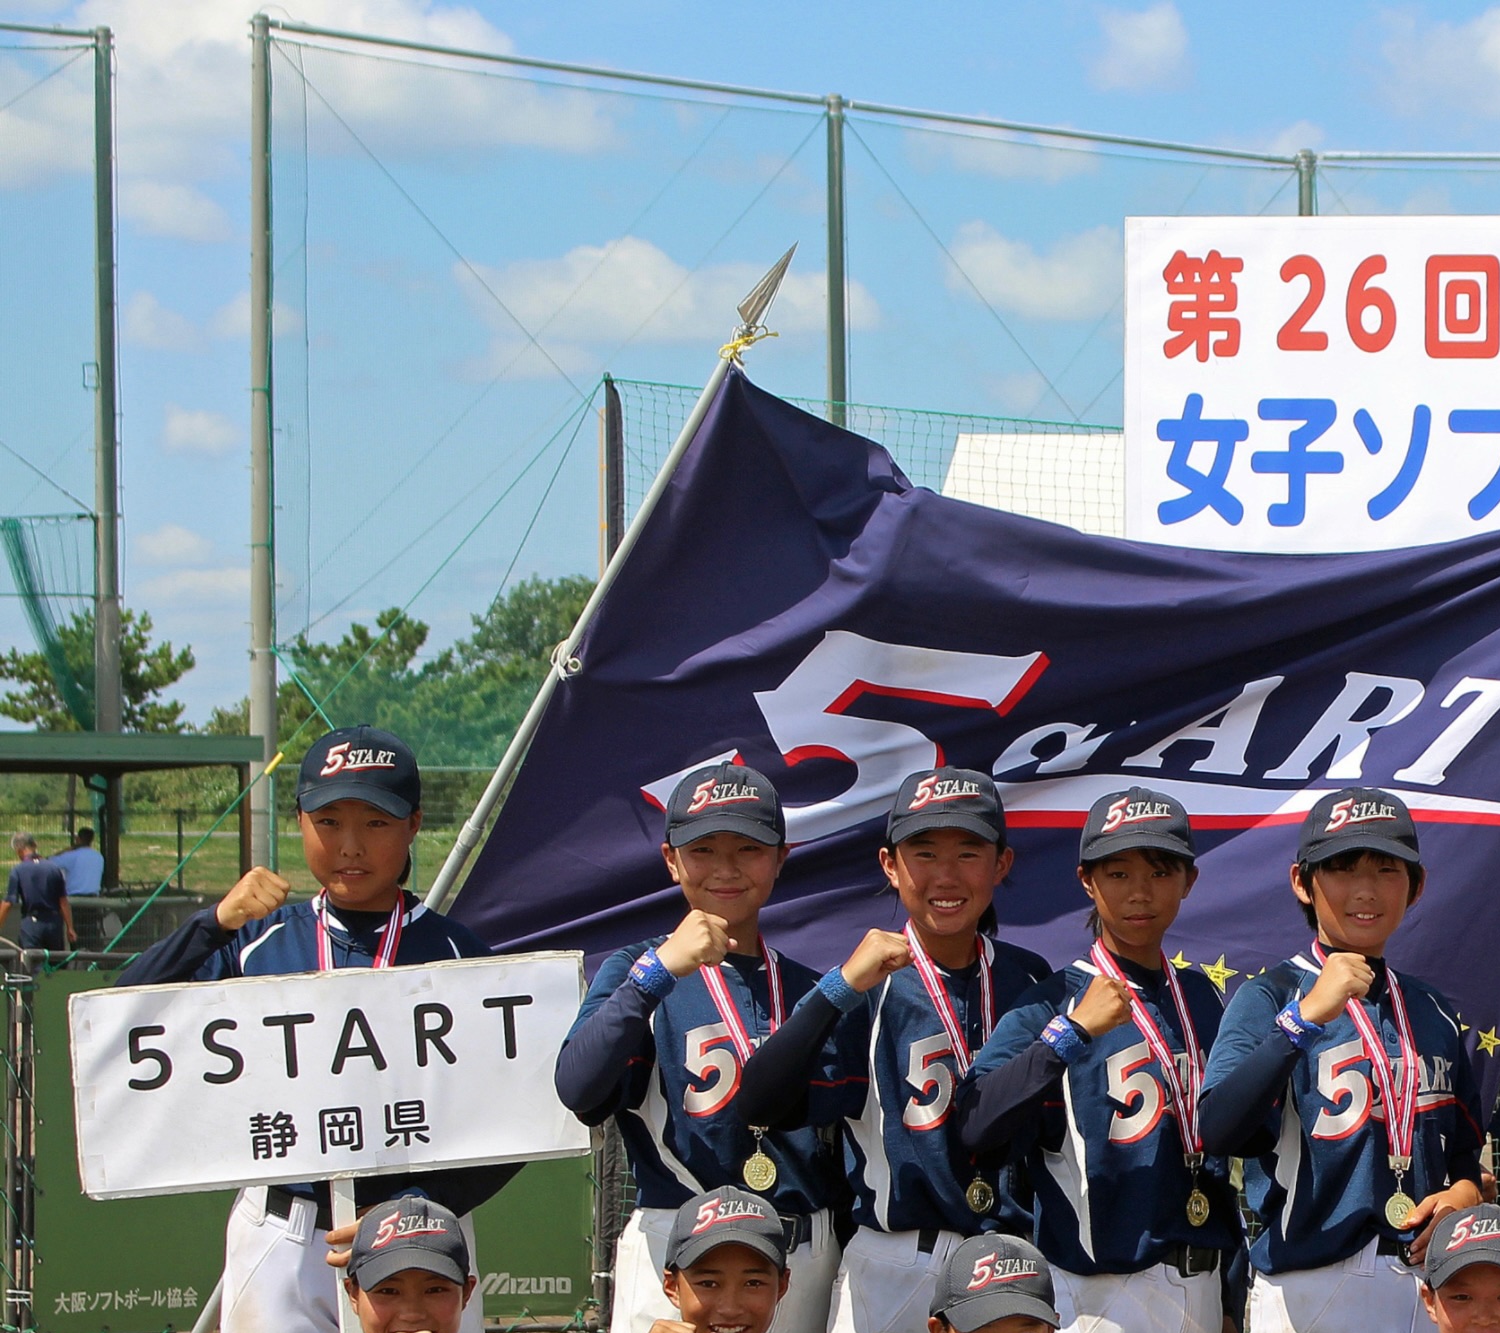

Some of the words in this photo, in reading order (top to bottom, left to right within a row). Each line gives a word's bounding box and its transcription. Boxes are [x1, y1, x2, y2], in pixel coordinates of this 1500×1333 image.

[320, 742, 395, 776] 5START
[687, 778, 759, 813] 5START
[908, 775, 980, 809] 5START
[1101, 797, 1171, 833] 5START
[1325, 798, 1396, 833] 5START
[127, 994, 533, 1090] 5START
[249, 1099, 431, 1161] 静岡県
[371, 1211, 447, 1248] 5START
[692, 1198, 764, 1234] 5START
[967, 1252, 1038, 1290] 5START
[54, 1286, 198, 1315] 大阪ソフトボール協会
